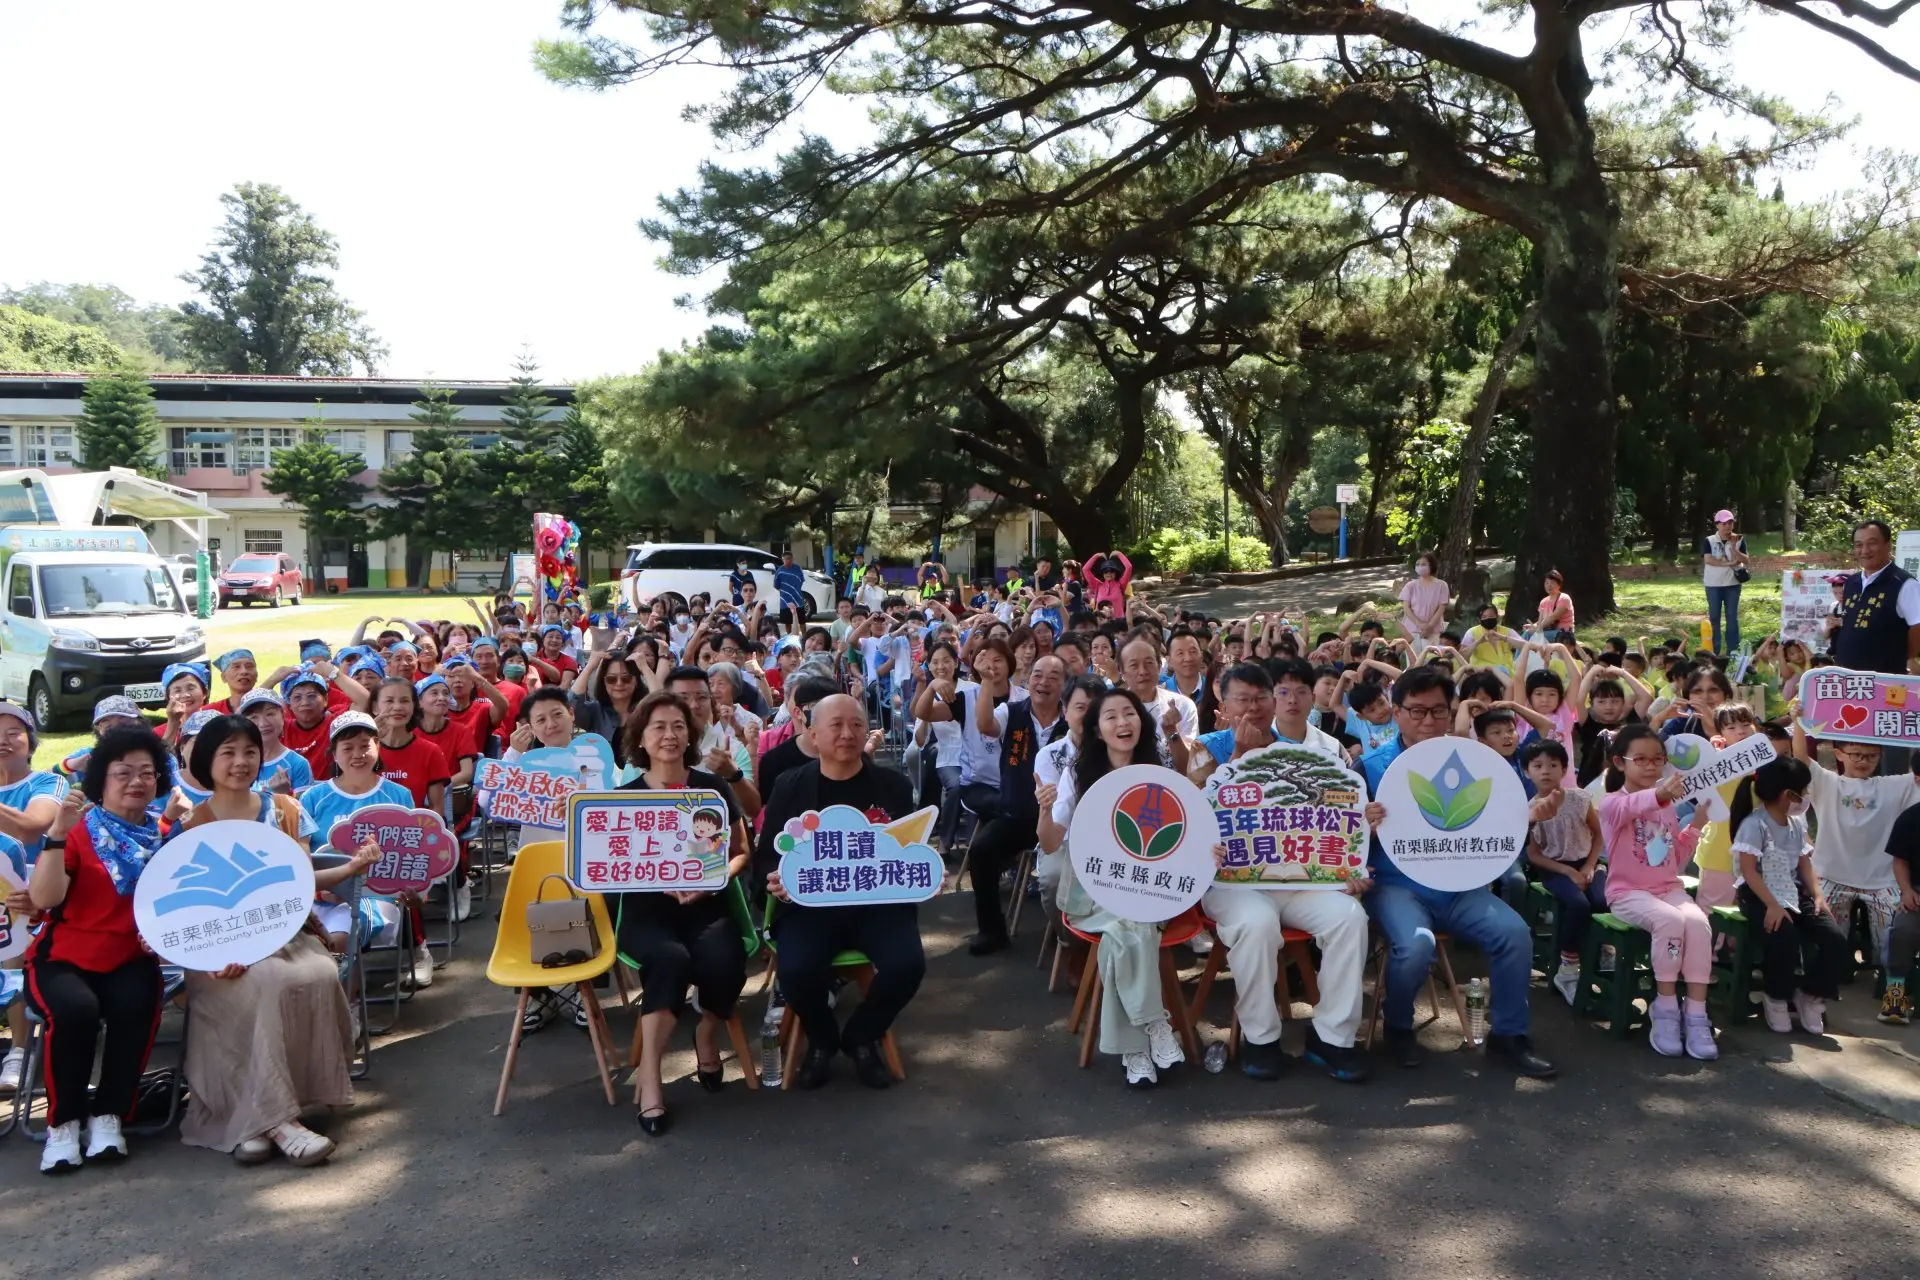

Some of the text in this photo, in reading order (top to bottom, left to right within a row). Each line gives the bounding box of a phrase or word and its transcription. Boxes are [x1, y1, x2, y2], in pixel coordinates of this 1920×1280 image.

[1815, 675, 1876, 701] 苗栗
[1222, 785, 1258, 805] 我在
[352, 822, 424, 849] 我們愛
[586, 810, 679, 833] 愛上閱讀
[608, 825, 662, 847] 愛上
[1214, 805, 1363, 838] 百年琉球松下
[813, 830, 876, 862] 閱讀
[1221, 834, 1348, 868] 遇見好書
[1392, 836, 1516, 855] 苗栗縣政府教育處
[368, 851, 430, 882] 閱讀
[586, 859, 703, 883] 更好的自己
[798, 859, 932, 894] 讓想像飛翔
[1085, 856, 1196, 894] 苗栗縣政府
[1092, 878, 1182, 903] Miaoli County Government
[160, 897, 304, 949] 苗栗縣立圖書館
[184, 920, 288, 954] Miaoli County Library
